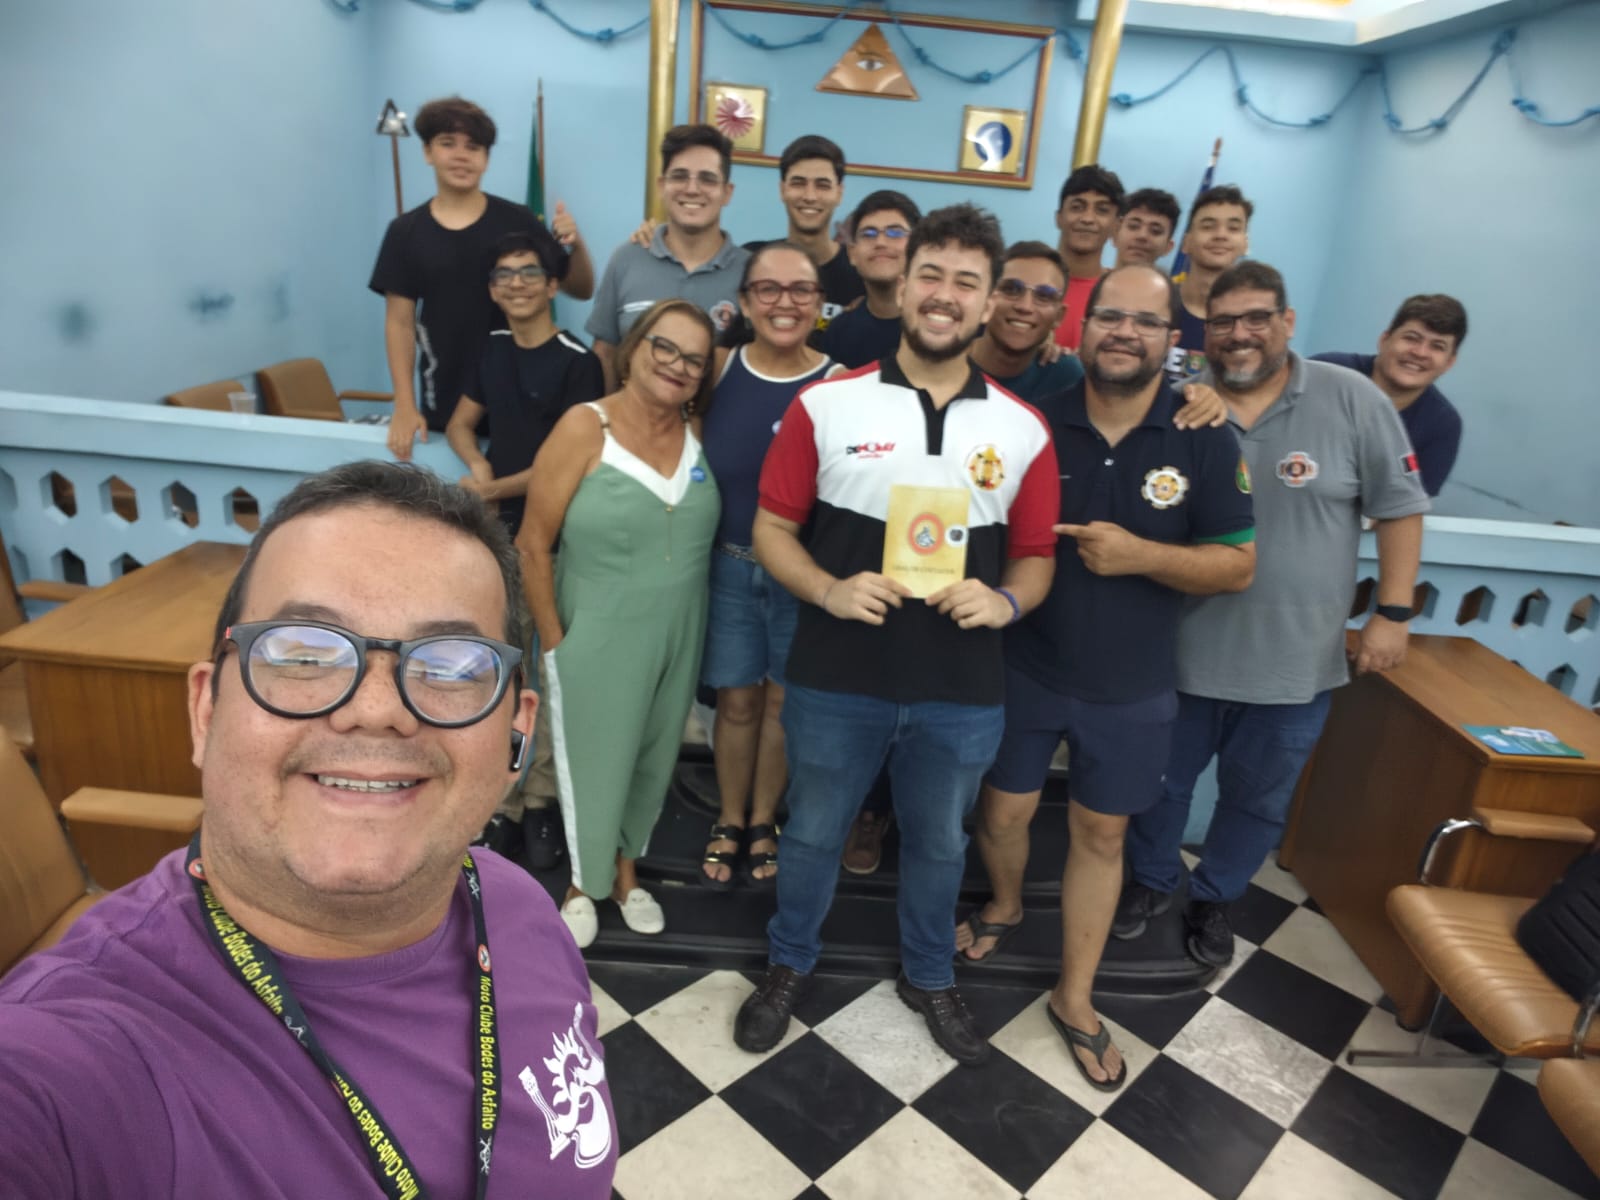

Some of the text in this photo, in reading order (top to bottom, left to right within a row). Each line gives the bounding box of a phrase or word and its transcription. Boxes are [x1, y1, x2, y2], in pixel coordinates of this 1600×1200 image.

[223, 931, 255, 967] Bodes
[241, 961, 265, 981] do
[251, 974, 284, 1015] Asfalto
[480, 975, 497, 1130] Moto Clube Bodes do Asfalto
[357, 1108, 385, 1147] Bodes
[376, 1138, 403, 1176] Clube
[396, 1167, 419, 1200] Moto
